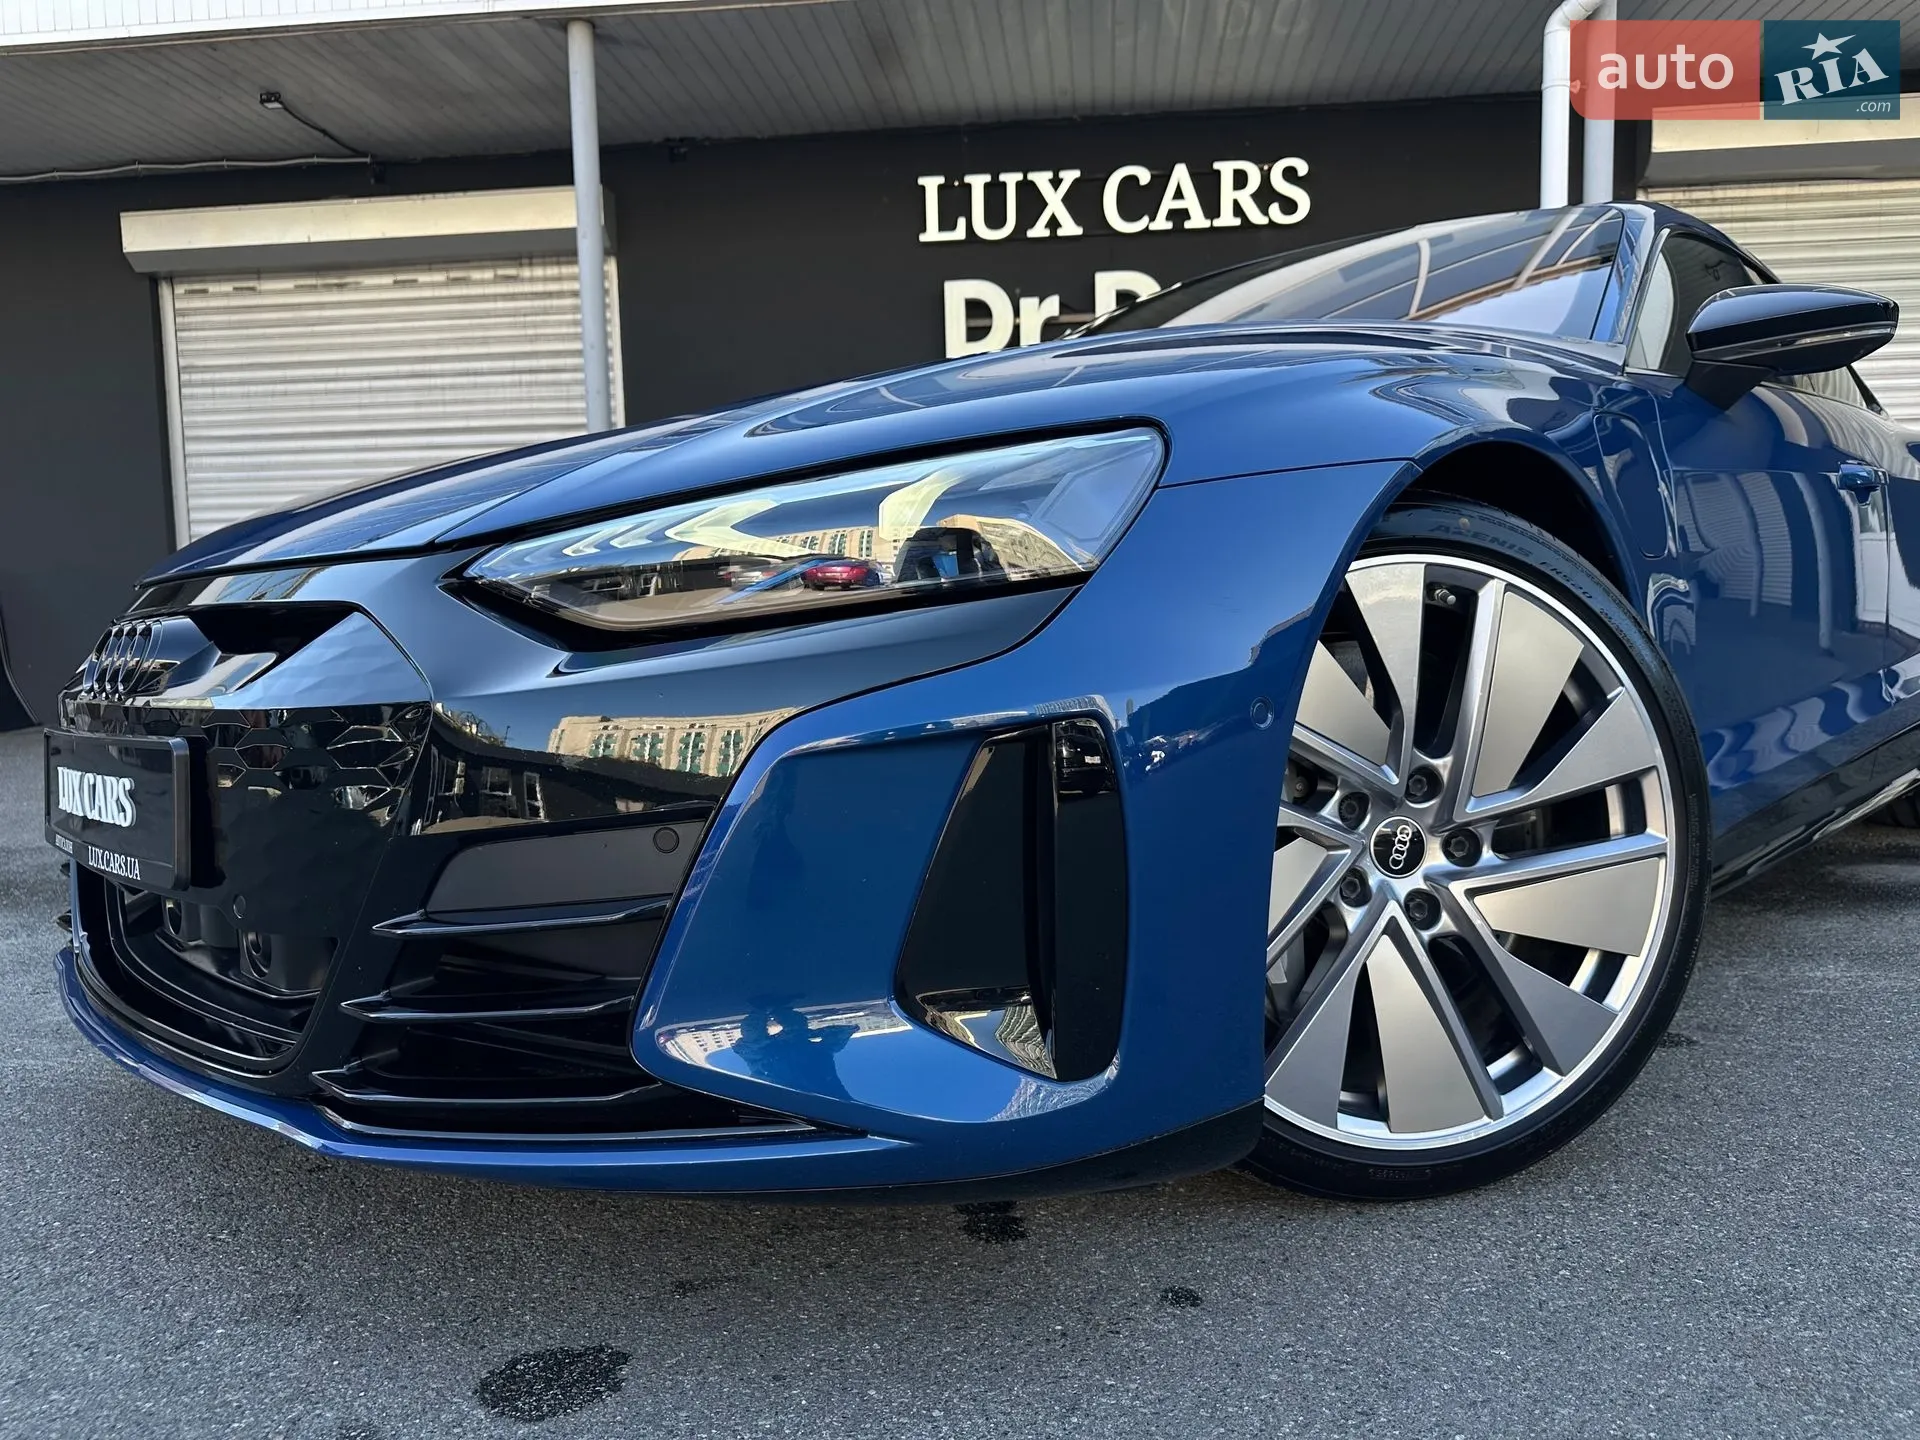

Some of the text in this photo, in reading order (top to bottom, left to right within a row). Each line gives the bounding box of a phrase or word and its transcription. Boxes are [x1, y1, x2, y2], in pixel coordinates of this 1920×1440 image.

[918, 156, 1312, 242] LUX CARS
[943, 279, 1060, 359] Dr
[57, 766, 136, 827] LUX CARS
